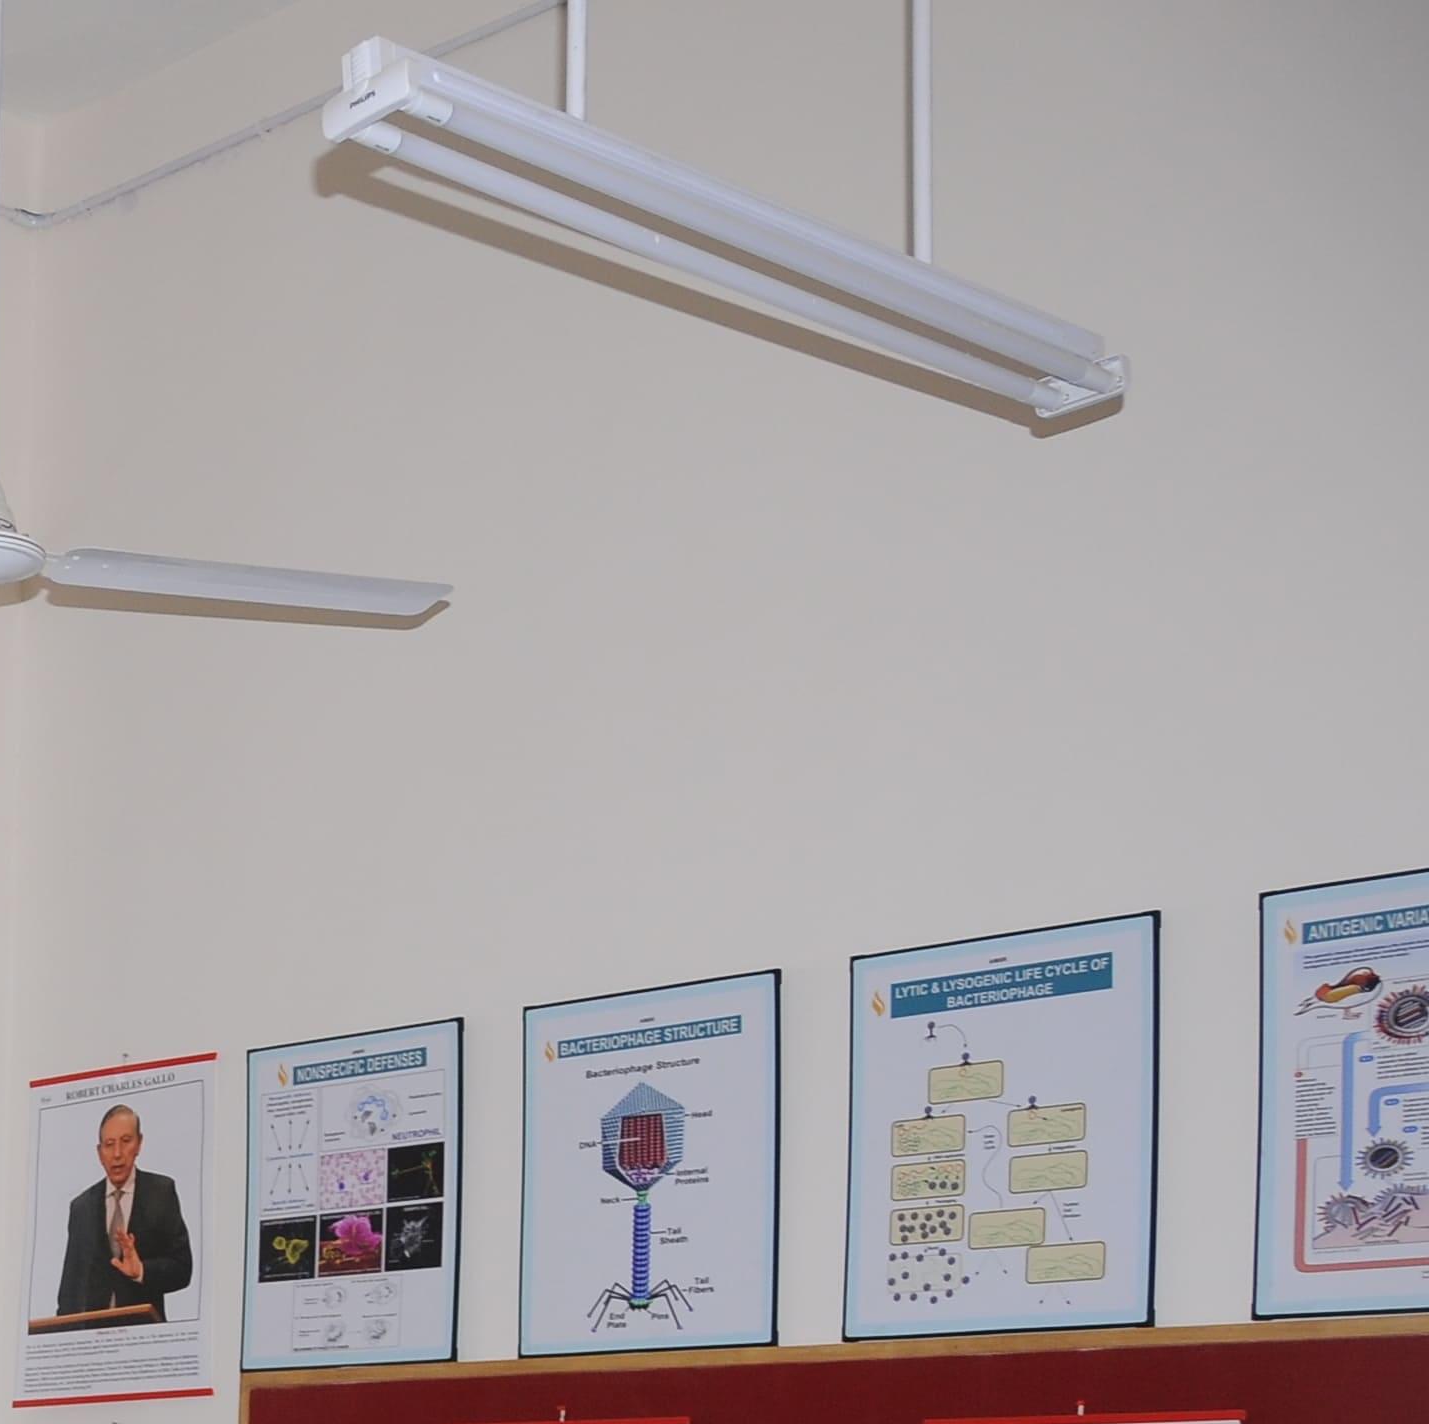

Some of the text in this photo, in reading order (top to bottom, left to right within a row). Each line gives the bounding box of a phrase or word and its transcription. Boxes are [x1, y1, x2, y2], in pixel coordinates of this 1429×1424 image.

[1308, 915, 1384, 940] ANTIGENIC
[895, 957, 1109, 999] LYTIC & LYSOGENIC LIFE CYCLE OF
[946, 982, 1054, 1008] BACTERIOPHAGE
[560, 1018, 739, 1056] BACTERIOPHAGE STRUCTURE
[296, 1051, 423, 1081] NONSPECIFIC DEFENSES
[586, 1057, 700, 1079] Bacteriophage Structure
[65, 1072, 176, 1101] ROBERT CHARLES GALLO
[579, 1141, 597, 1150] DNA
